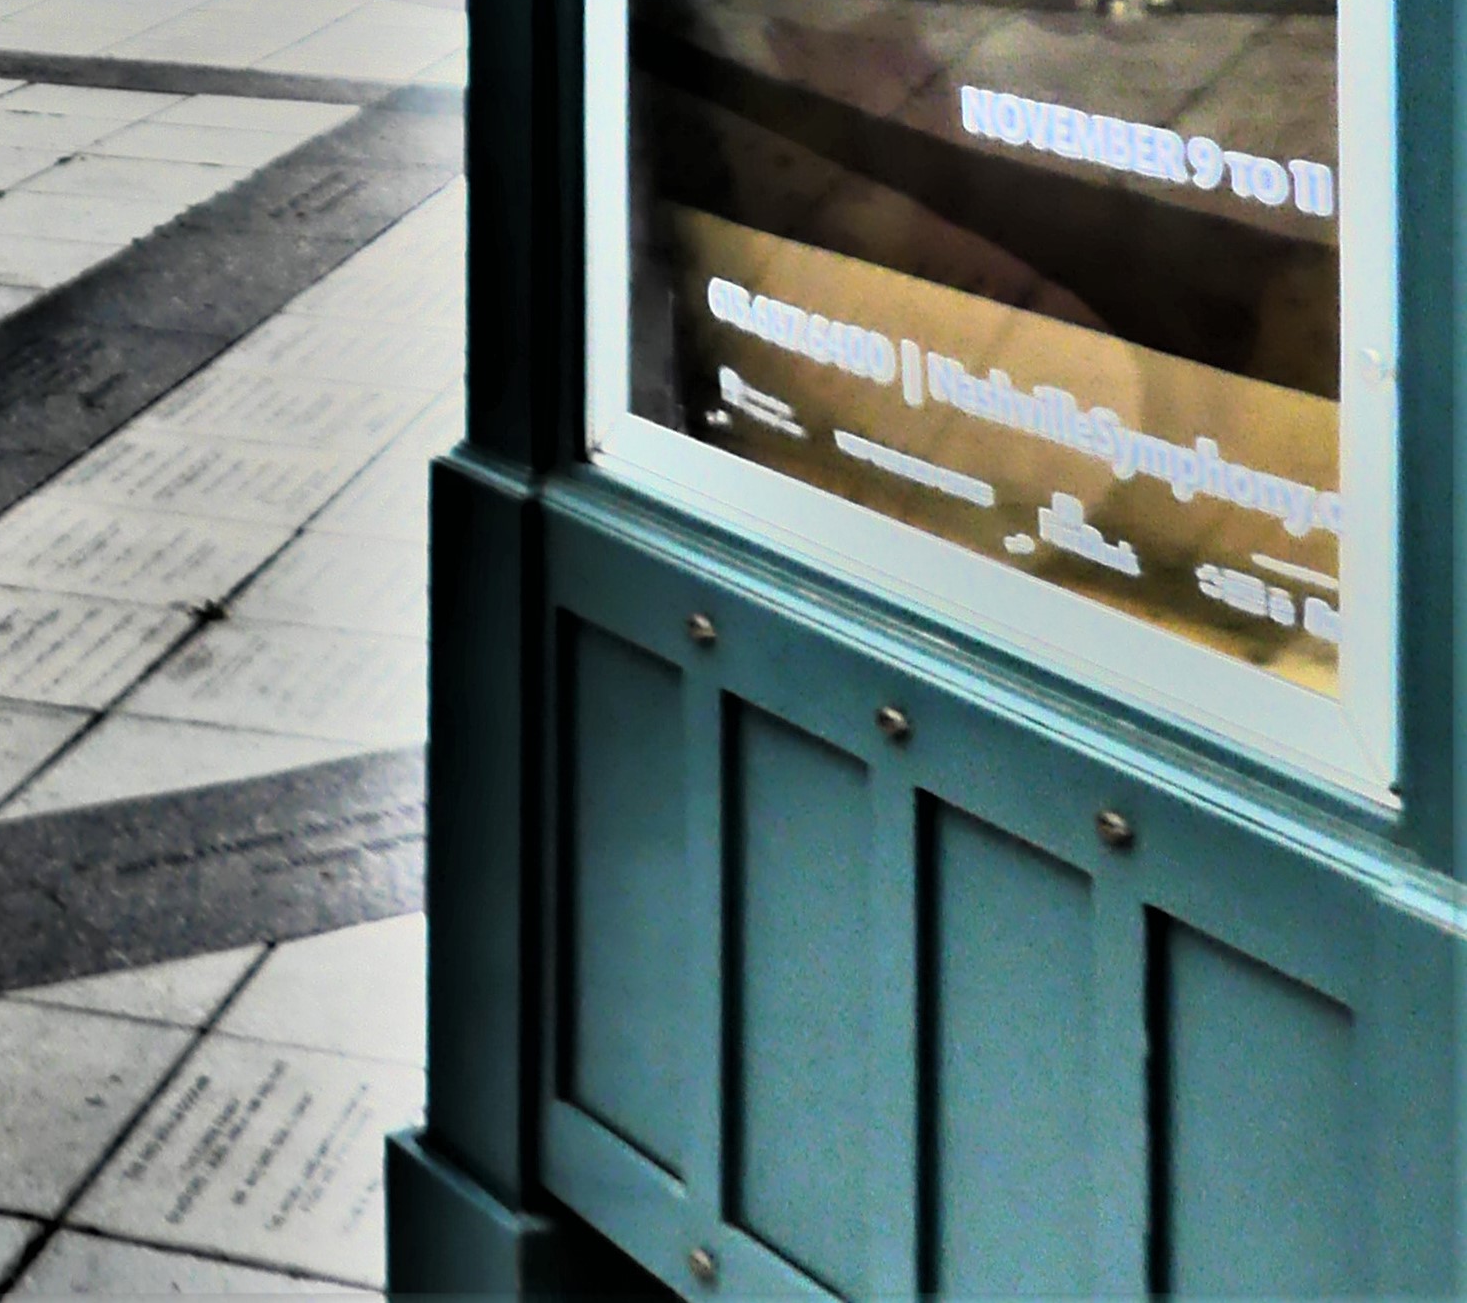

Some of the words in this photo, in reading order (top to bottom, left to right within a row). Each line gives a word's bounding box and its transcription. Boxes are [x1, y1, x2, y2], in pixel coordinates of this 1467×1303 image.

[960, 84, 1189, 184] NOVEMBER
[1186, 135, 1224, 190] 9
[1223, 150, 1290, 207] TO
